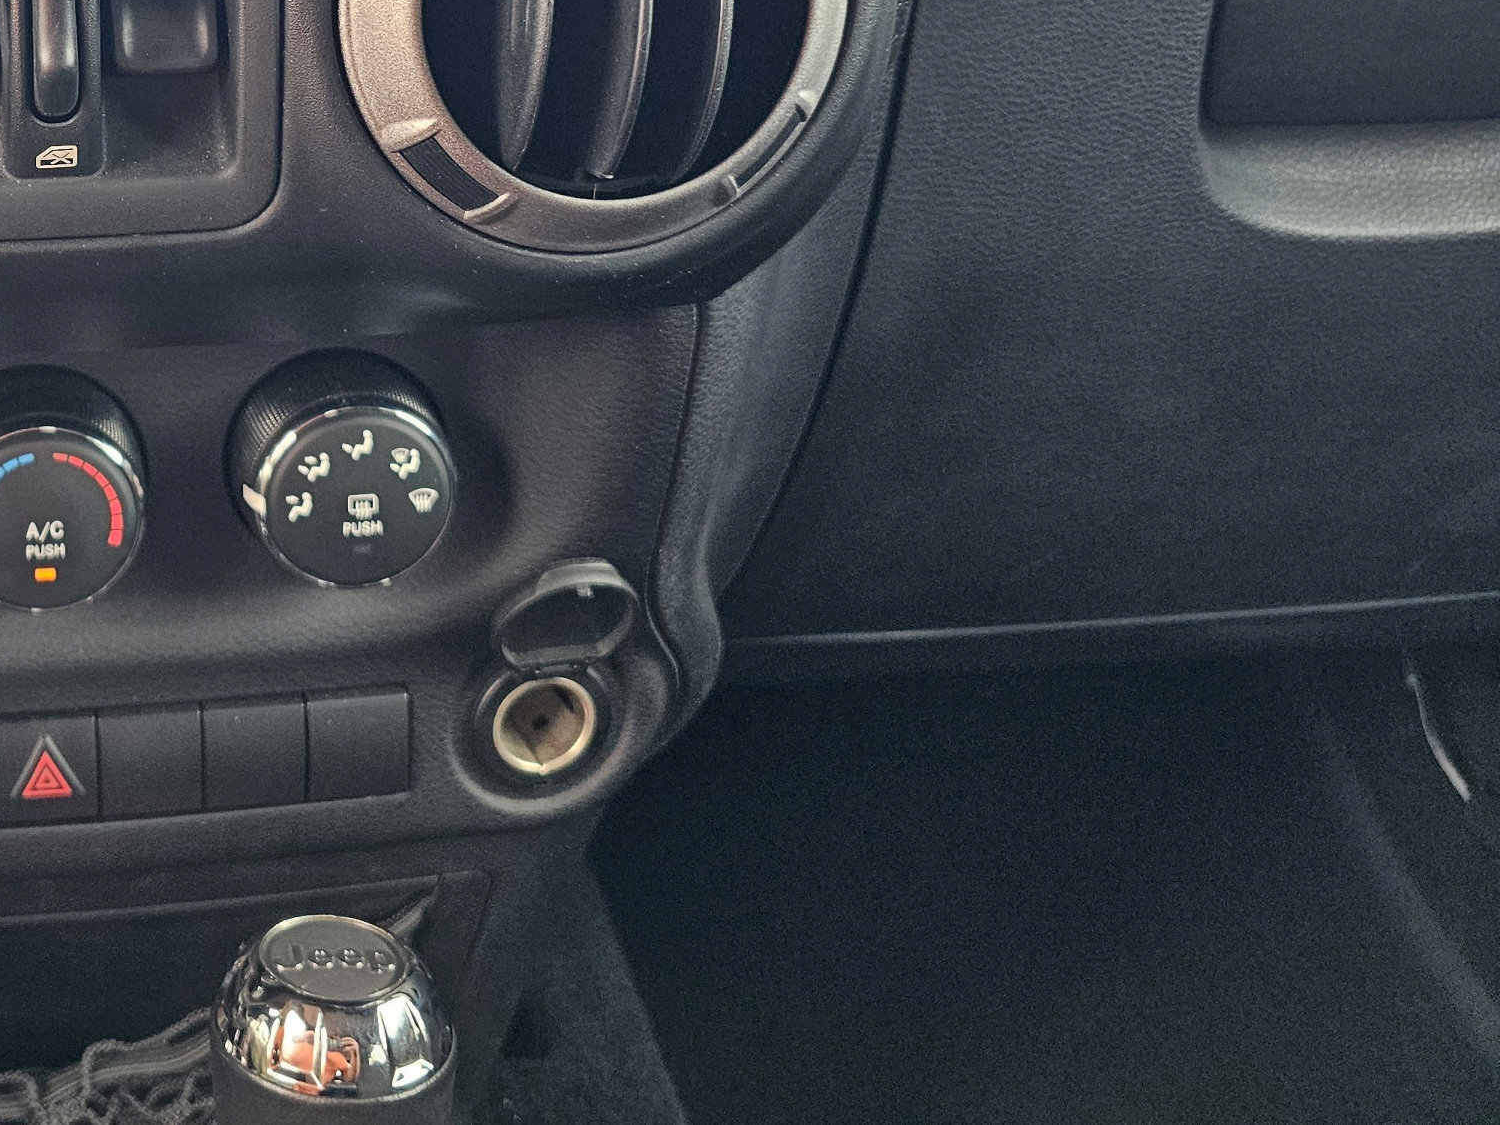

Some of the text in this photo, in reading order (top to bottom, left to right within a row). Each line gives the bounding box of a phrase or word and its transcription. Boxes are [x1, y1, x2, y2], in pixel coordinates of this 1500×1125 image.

[25, 520, 65, 543] A/C
[342, 520, 384, 538] PUSH
[25, 542, 66, 562] PUSH
[275, 943, 397, 976] Jeep
